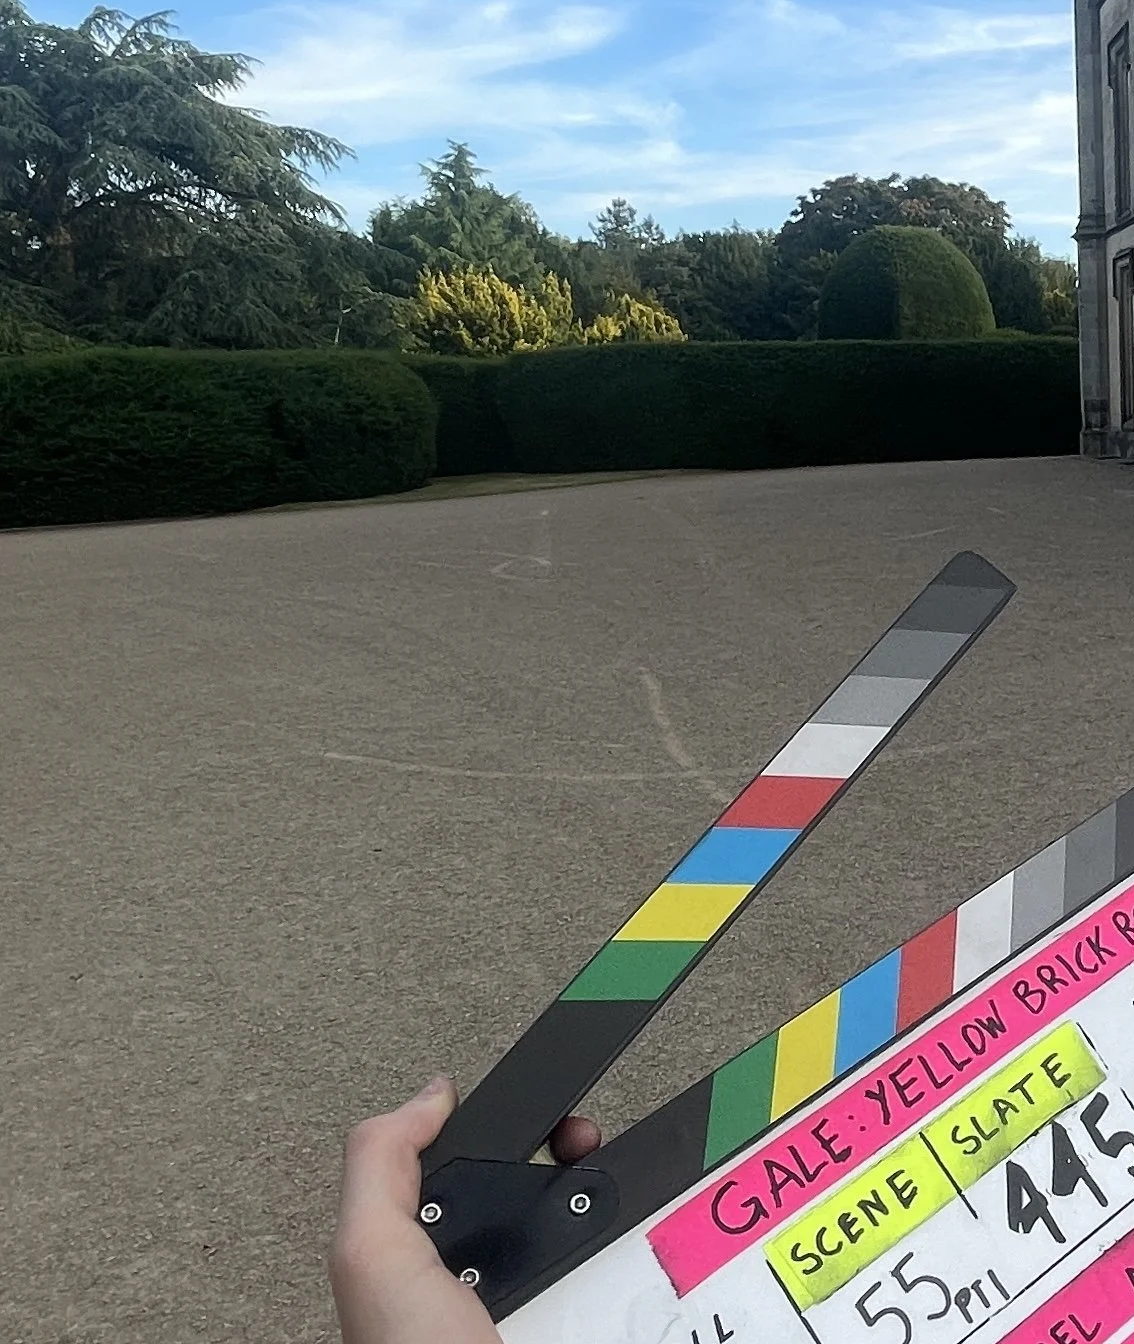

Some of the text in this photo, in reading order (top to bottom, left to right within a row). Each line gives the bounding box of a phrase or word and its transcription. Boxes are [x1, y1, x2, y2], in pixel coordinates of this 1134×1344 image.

[864, 999, 1007, 1126] YELLOW
[1012, 926, 1117, 1014] BRICK
[951, 1052, 1072, 1156] SLATE
[790, 1169, 918, 1276] SCENE
